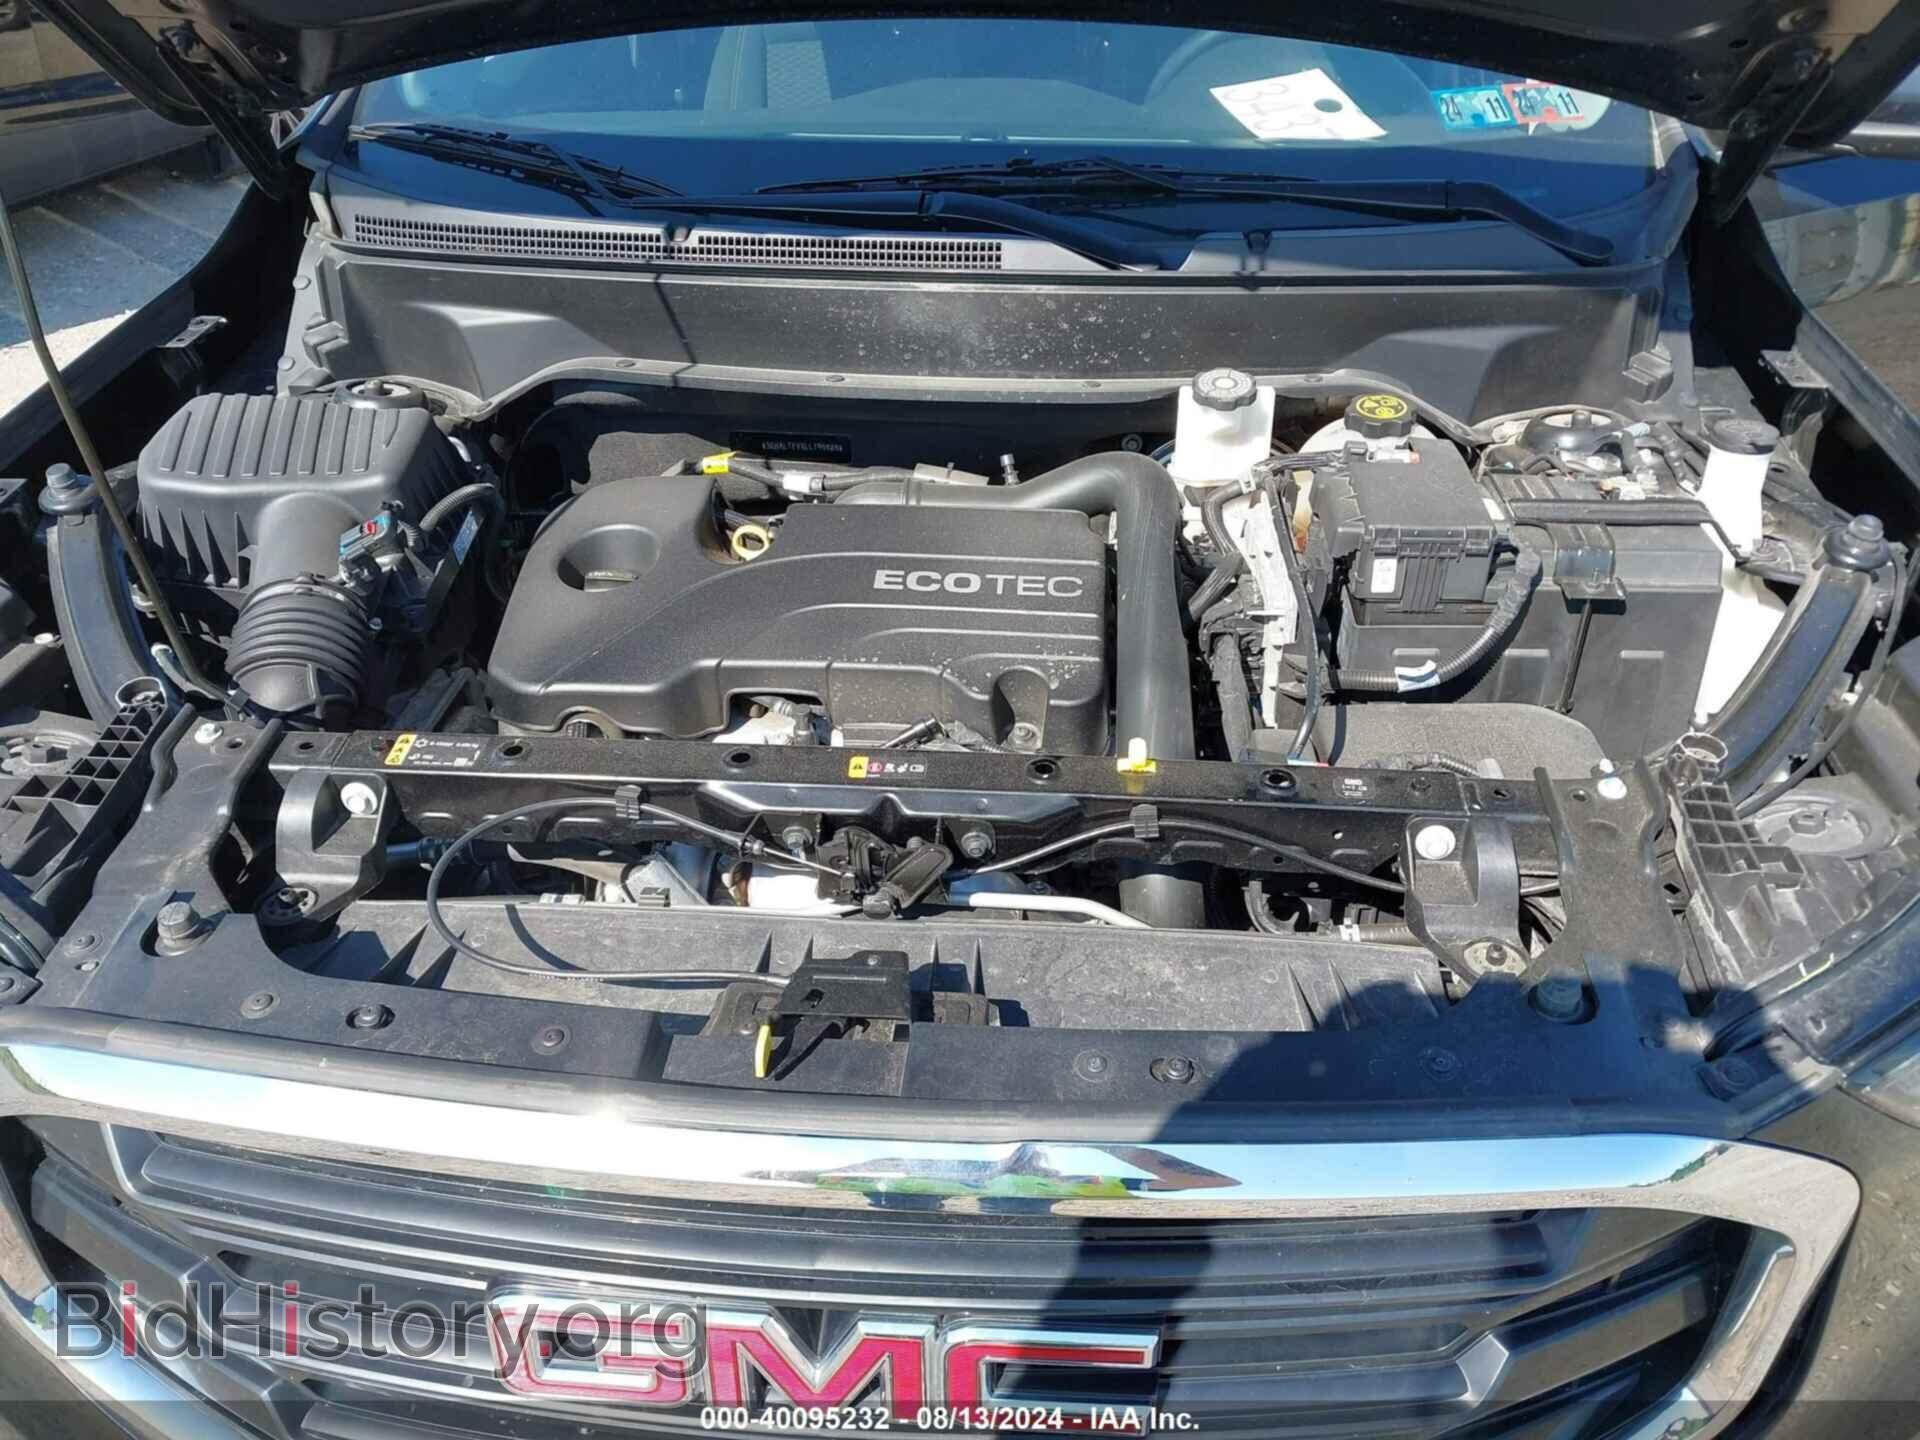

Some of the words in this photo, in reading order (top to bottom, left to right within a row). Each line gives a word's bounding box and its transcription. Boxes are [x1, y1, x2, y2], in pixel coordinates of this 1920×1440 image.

[1439, 95, 1463, 122] 24
[1486, 96, 1508, 119] 11
[1511, 90, 1537, 116] 24
[1557, 91, 1580, 114] 11
[873, 569, 1083, 598] ECOTEC
[486, 1290, 1159, 1436] GMC
